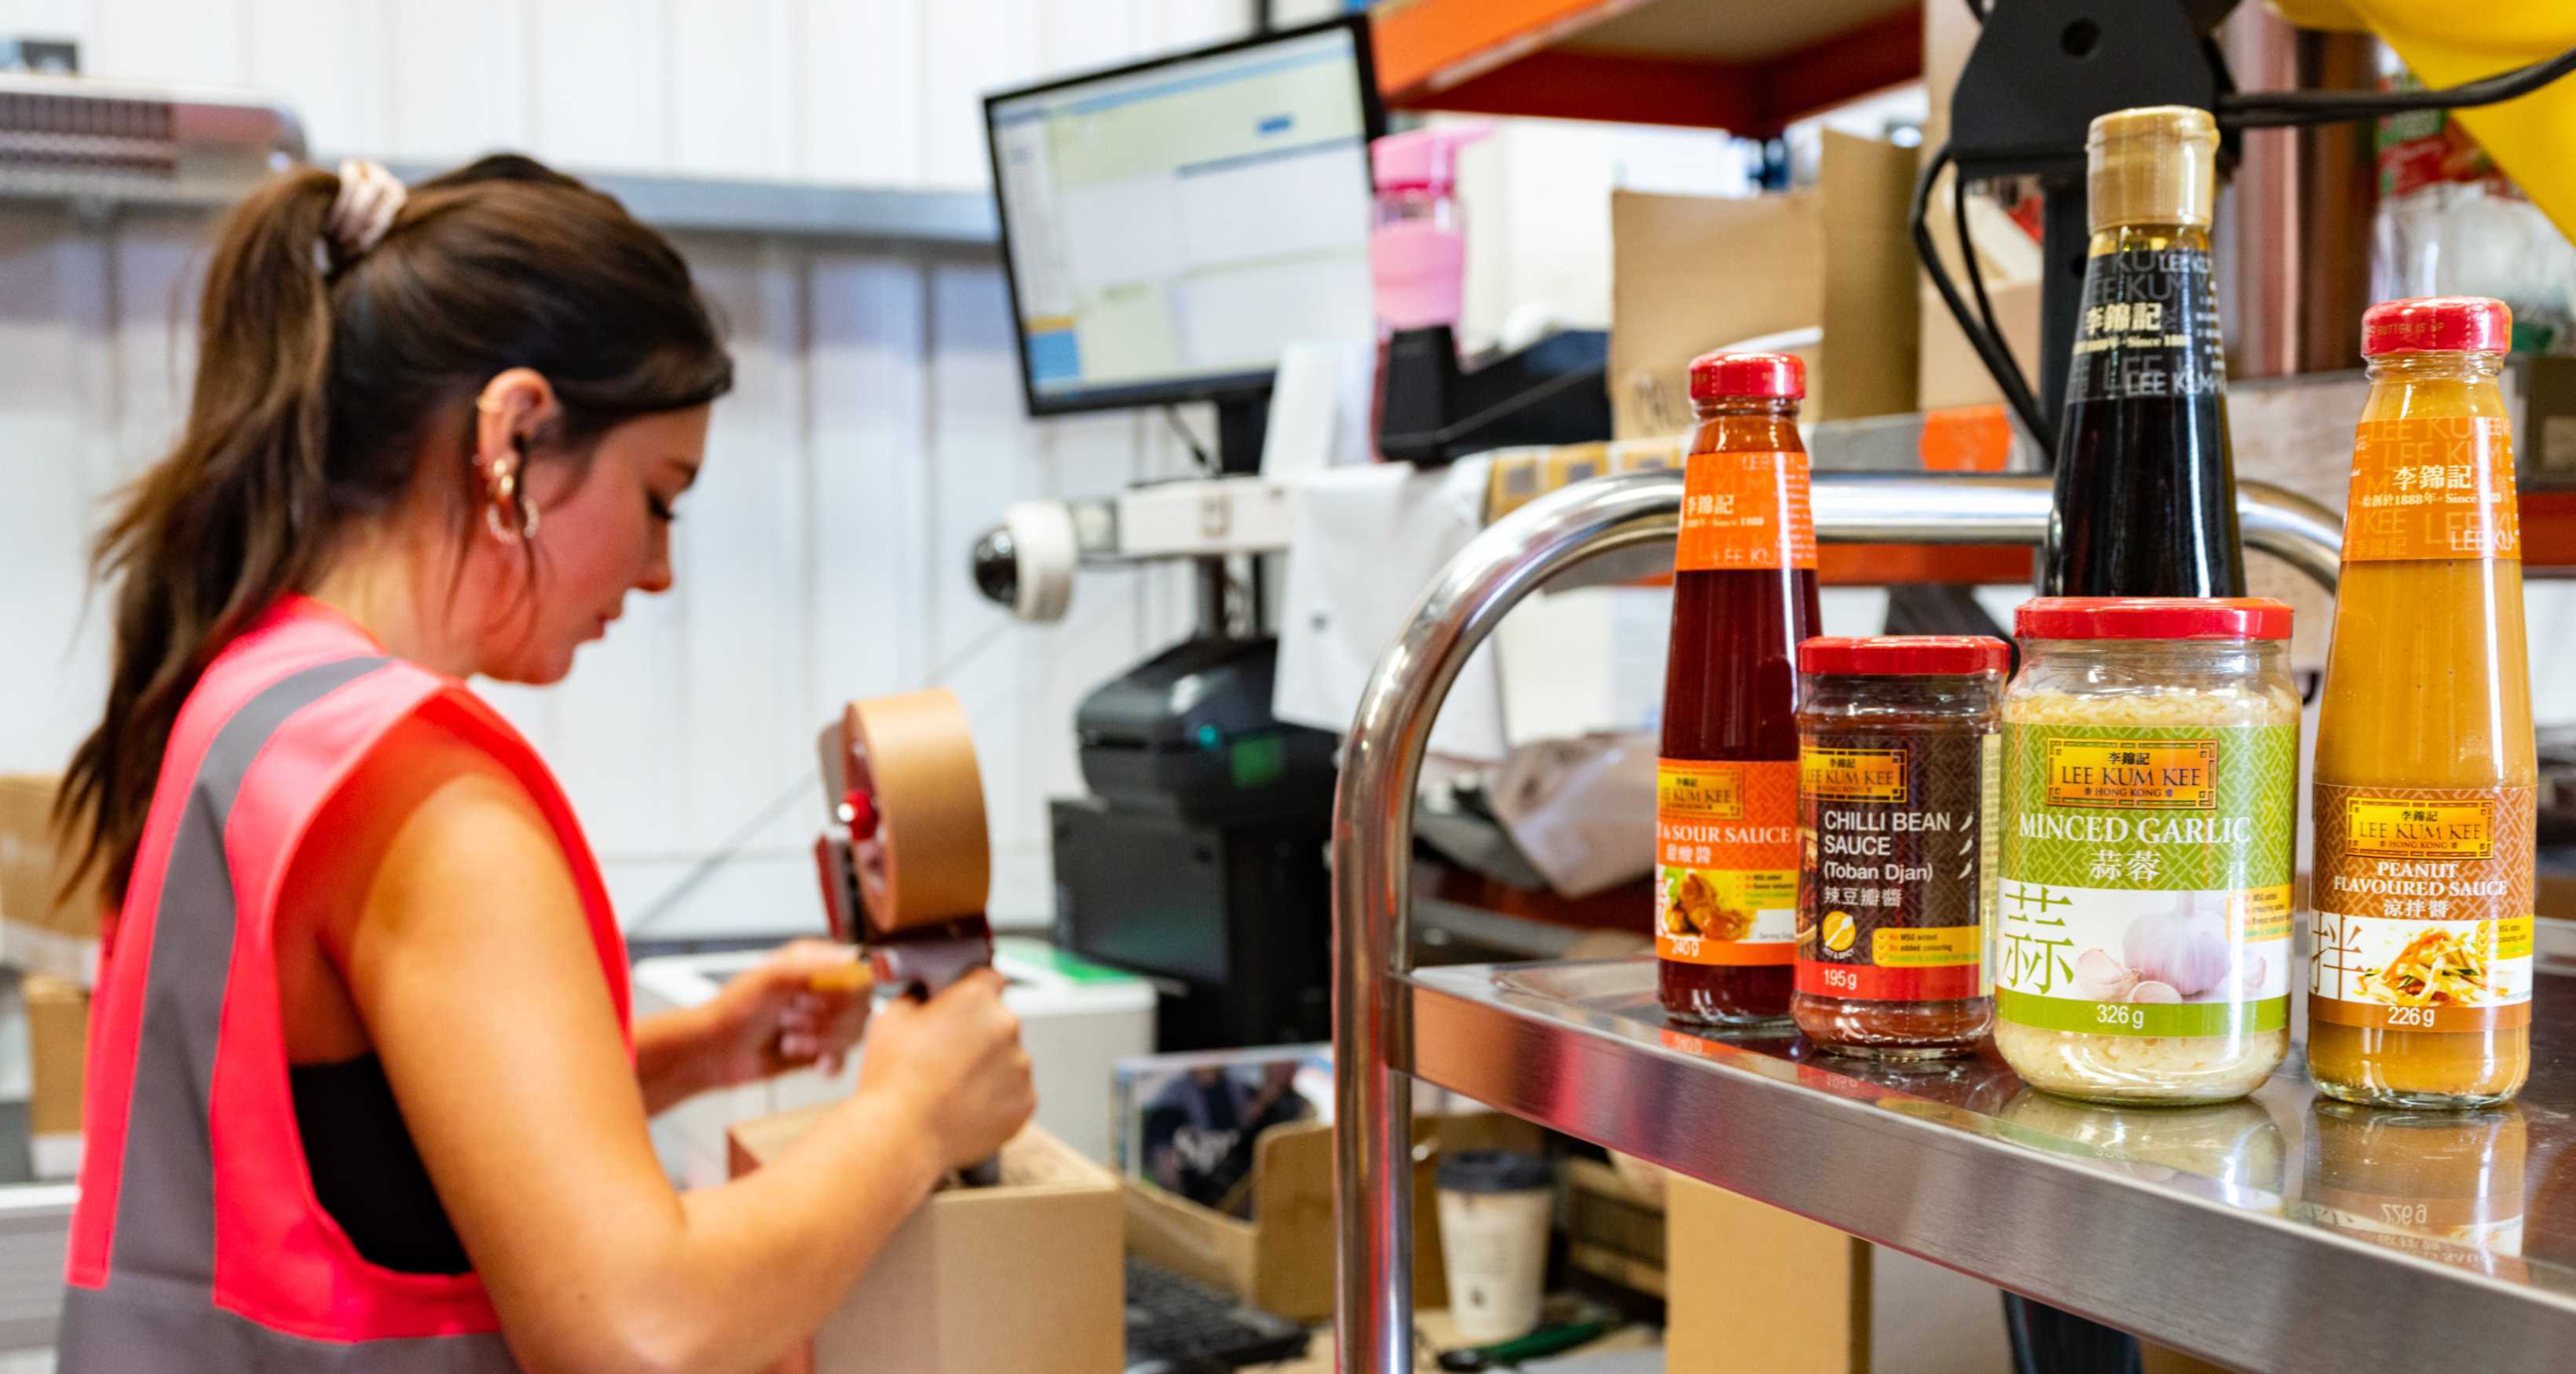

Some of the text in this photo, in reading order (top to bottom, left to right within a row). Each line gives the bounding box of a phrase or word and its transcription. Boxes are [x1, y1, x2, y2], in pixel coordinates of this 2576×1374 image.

[2392, 465, 2472, 491] 李錦記
[2108, 751, 2151, 766] 李錦記
[1826, 769, 1860, 785] KUM
[1864, 770, 1894, 786] KEE
[2062, 766, 2201, 787] LEE KUM KEE
[2095, 787, 2162, 798] HONG KONG
[1824, 810, 1951, 831] CHILLI BEAN
[2401, 809, 2438, 823] 李錦記
[1672, 824, 1720, 843] SOUR
[1725, 826, 1791, 844] SAUCE
[2018, 812, 2252, 845] MINCED GARLIC
[2359, 821, 2482, 840] LEE KUM KEE
[1824, 835, 1892, 856] SAUCE
[2389, 840, 2448, 850] HONG KONG
[1824, 861, 1934, 883] (Toban Djan)
[2089, 850, 2161, 882] 蒜蓉
[2377, 861, 2460, 879] PEANUT
[2333, 875, 2508, 897] FLAVOURED SAUCE
[2003, 883, 2075, 996] 蒜
[2096, 1004, 2145, 1029] 326 g
[2388, 1006, 2435, 1028] 226 g
